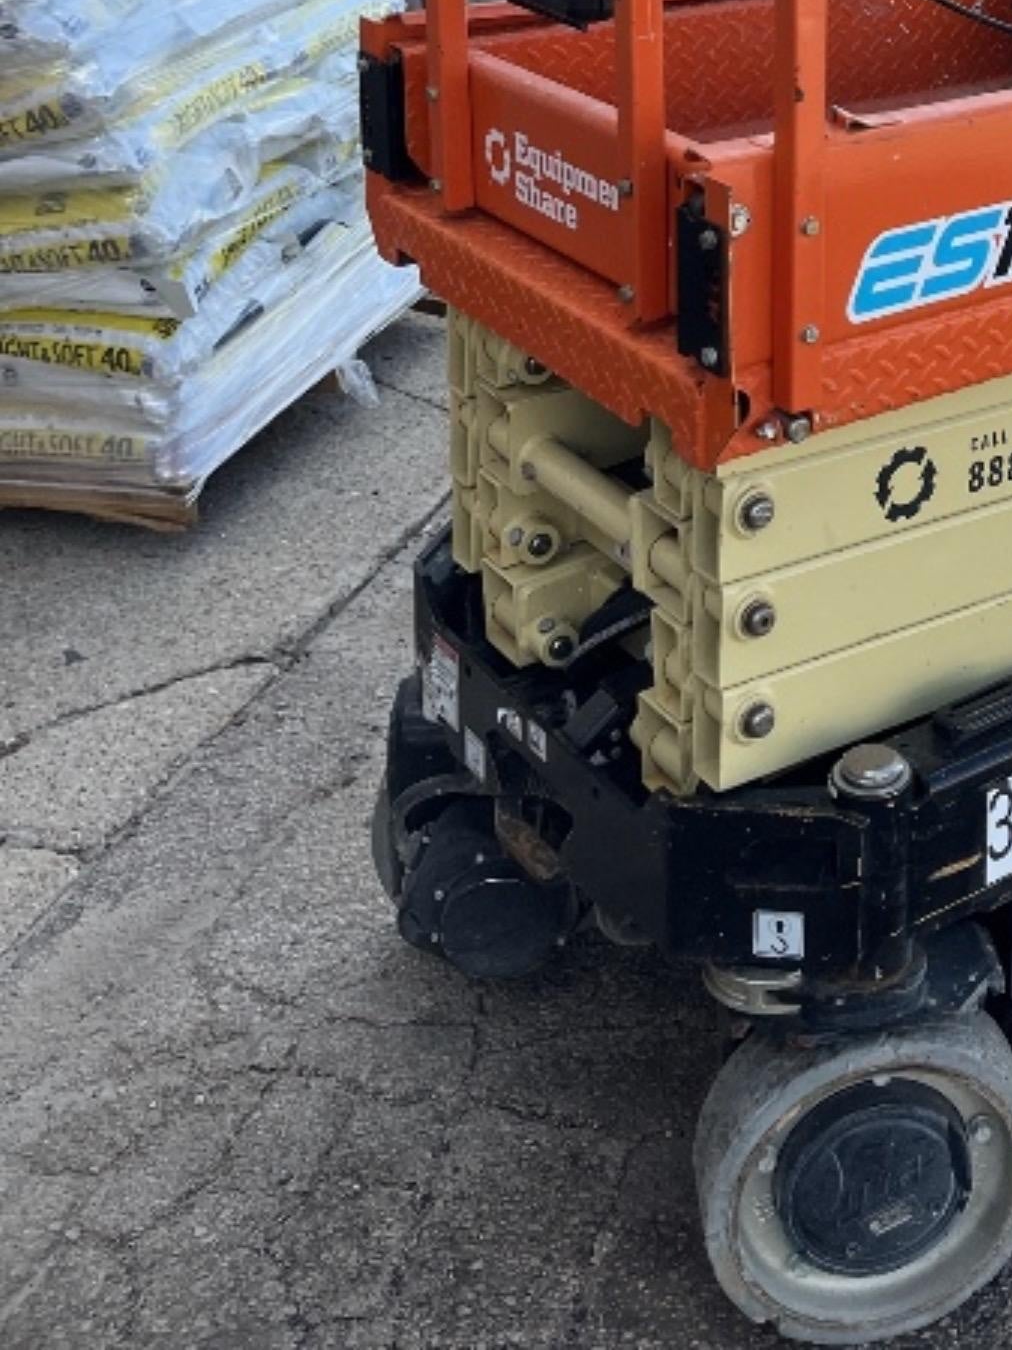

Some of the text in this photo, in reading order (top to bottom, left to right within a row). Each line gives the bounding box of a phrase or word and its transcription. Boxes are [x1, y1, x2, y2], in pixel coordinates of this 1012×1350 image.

[514, 131, 619, 212] Equipmen
[515, 170, 578, 230] Share
[101, 347, 129, 372] 40
[970, 429, 1008, 452] CALL
